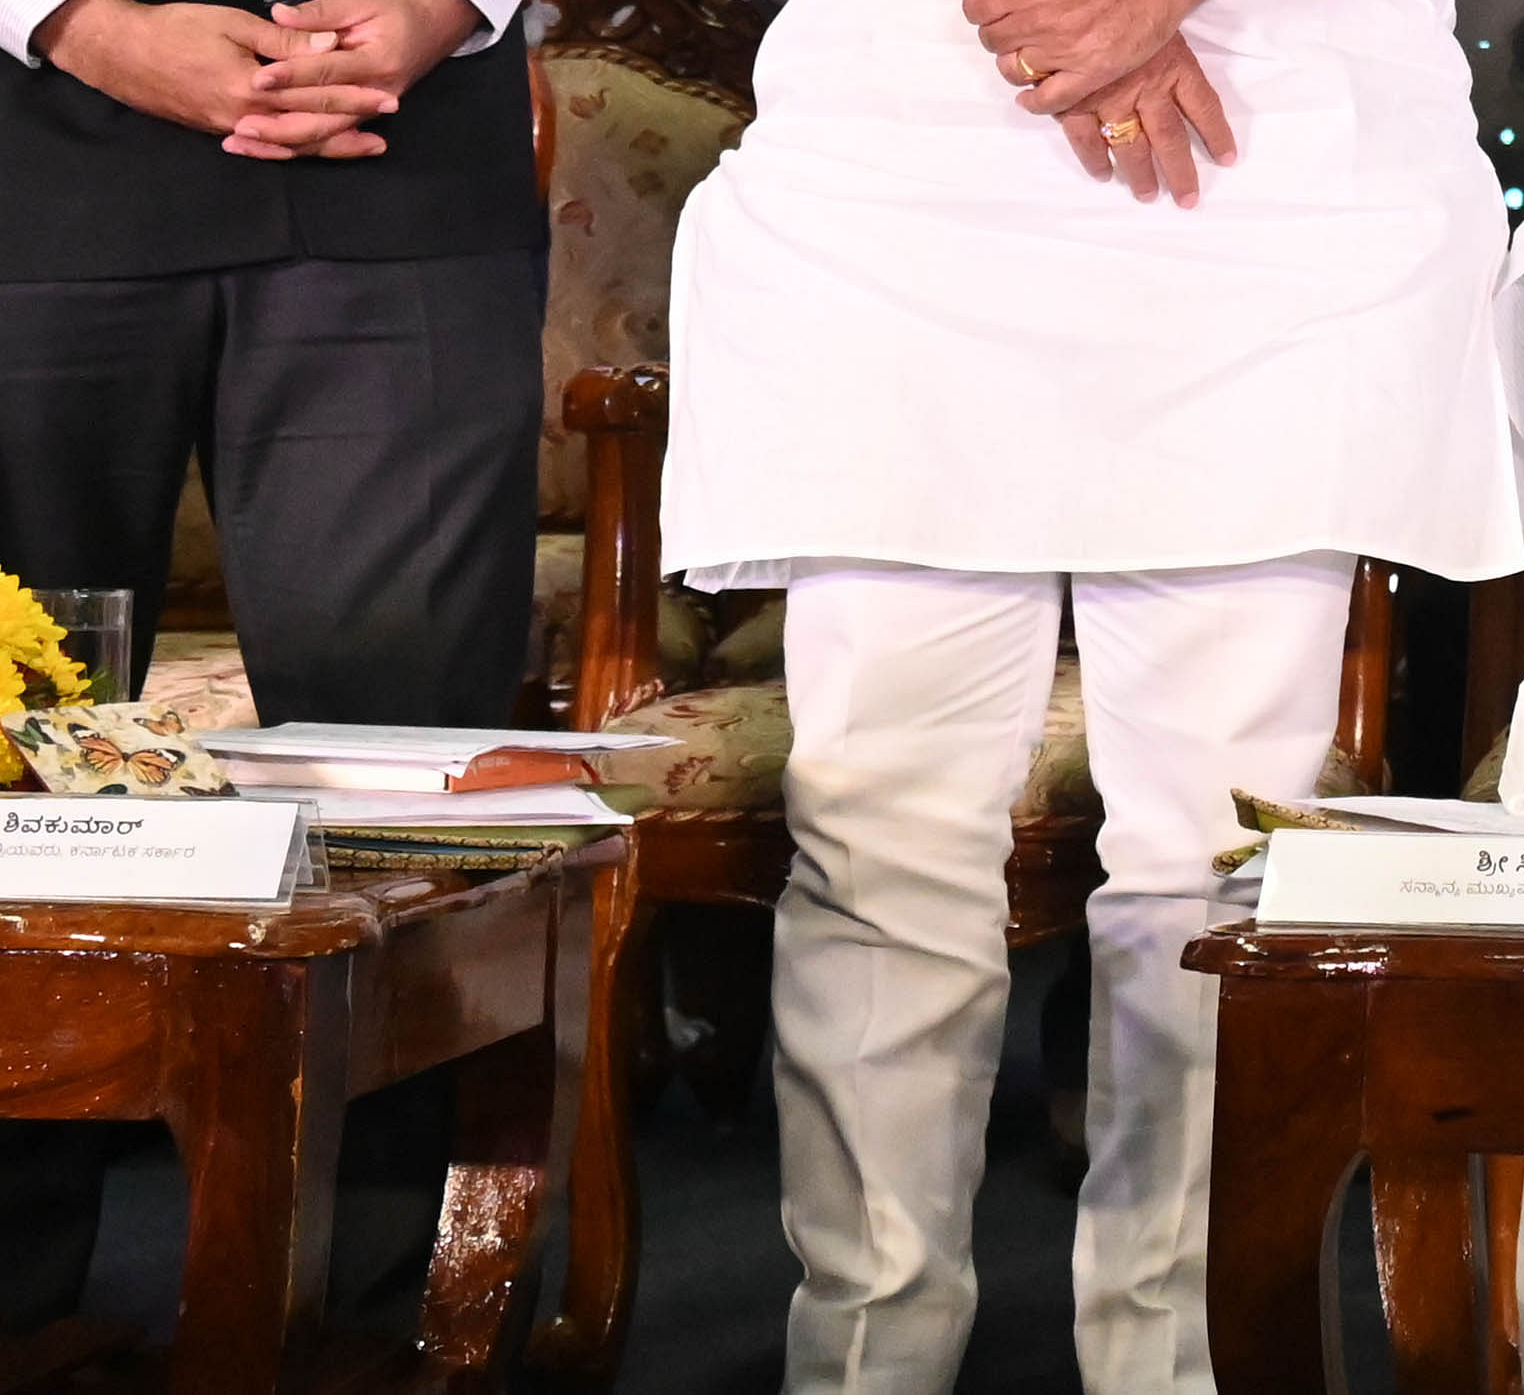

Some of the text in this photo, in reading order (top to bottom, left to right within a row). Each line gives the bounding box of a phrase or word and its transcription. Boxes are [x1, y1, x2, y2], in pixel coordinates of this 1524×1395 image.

[3, 811, 145, 836] ಶಿವಕುಮಾರ್
[70, 843, 139, 860] ಕರ್ನಾಟಕ
[143, 844, 197, 860] ಸರ್ಕಾರ
[1476, 849, 1509, 877] ಶ್ರೀ
[1400, 878, 1460, 897] ಸನ್ಮಾನ್ಯ
